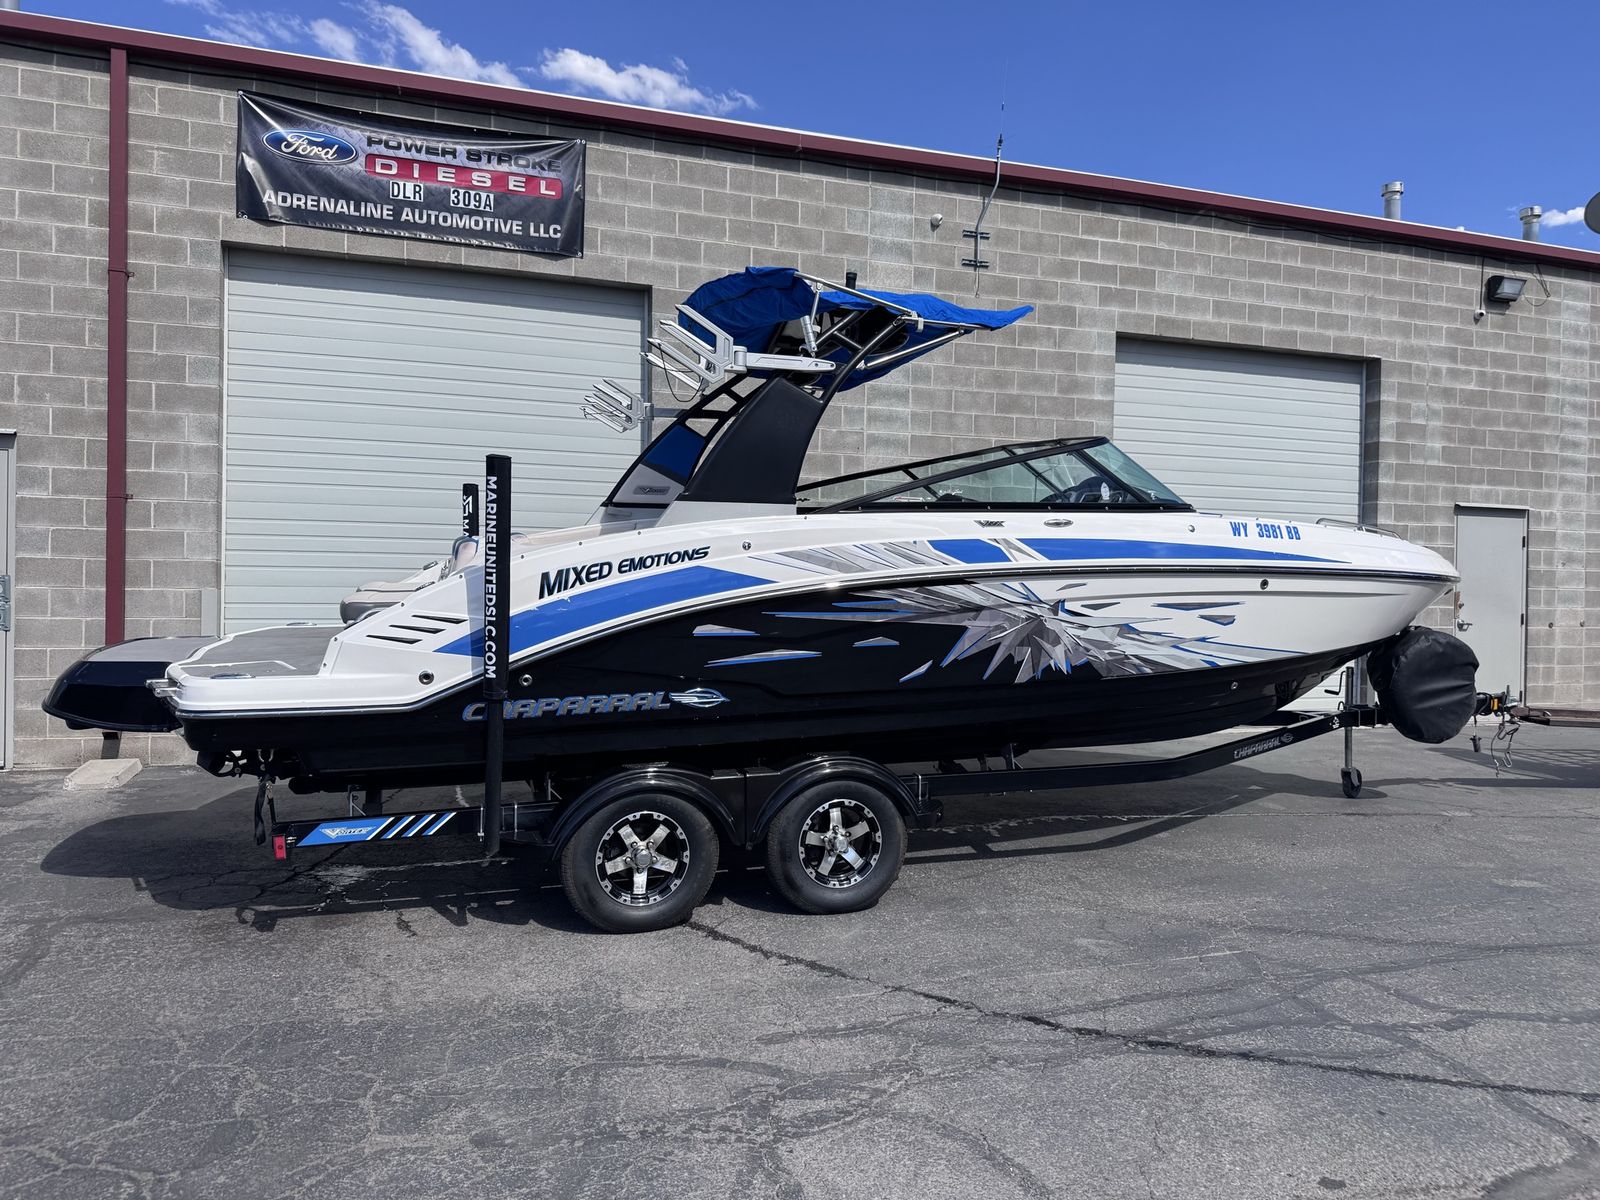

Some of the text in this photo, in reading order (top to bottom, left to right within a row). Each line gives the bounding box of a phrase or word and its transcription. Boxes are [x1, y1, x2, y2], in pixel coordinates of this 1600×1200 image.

[280, 132, 339, 160] Ford
[366, 135, 562, 173] POWER STROKE
[374, 158, 557, 196] DIESEL
[391, 181, 493, 211] DLR 309A
[262, 189, 562, 239] ADRENALINE AUTOMOTIVE LLC
[1229, 521, 1302, 541] WY 3981 BB
[485, 475, 498, 679] MARINEUNITEDSLC.COM
[538, 545, 711, 601] MIXED EMOTIONS
